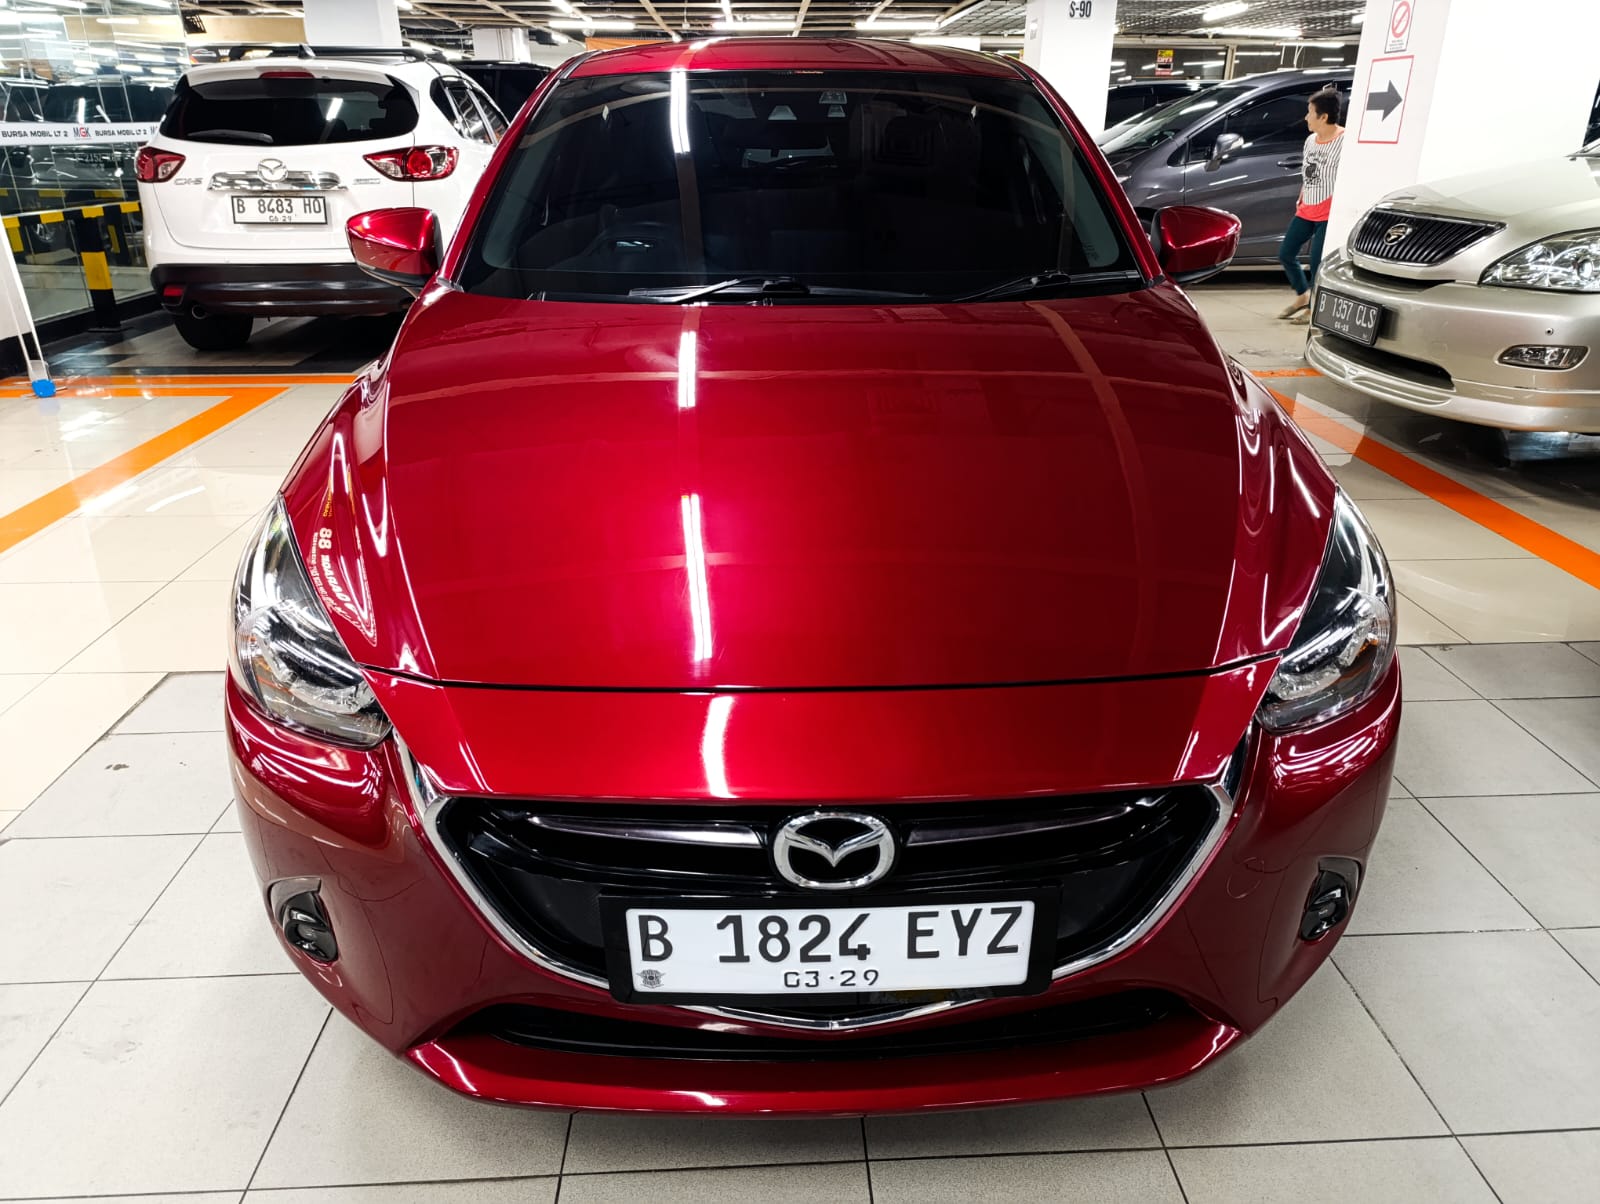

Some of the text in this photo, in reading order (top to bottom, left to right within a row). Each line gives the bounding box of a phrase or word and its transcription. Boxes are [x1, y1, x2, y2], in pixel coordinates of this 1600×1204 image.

[1069, 0, 1092, 18] S-90
[1, 130, 28, 138] BURSA
[30, 130, 52, 138] MOBIL
[73, 126, 91, 138] MGK
[236, 198, 246, 214] B
[257, 198, 293, 214] 8483
[1319, 293, 1376, 329] B 1357 CLS
[637, 905, 1023, 963] B 1824 EYZ
